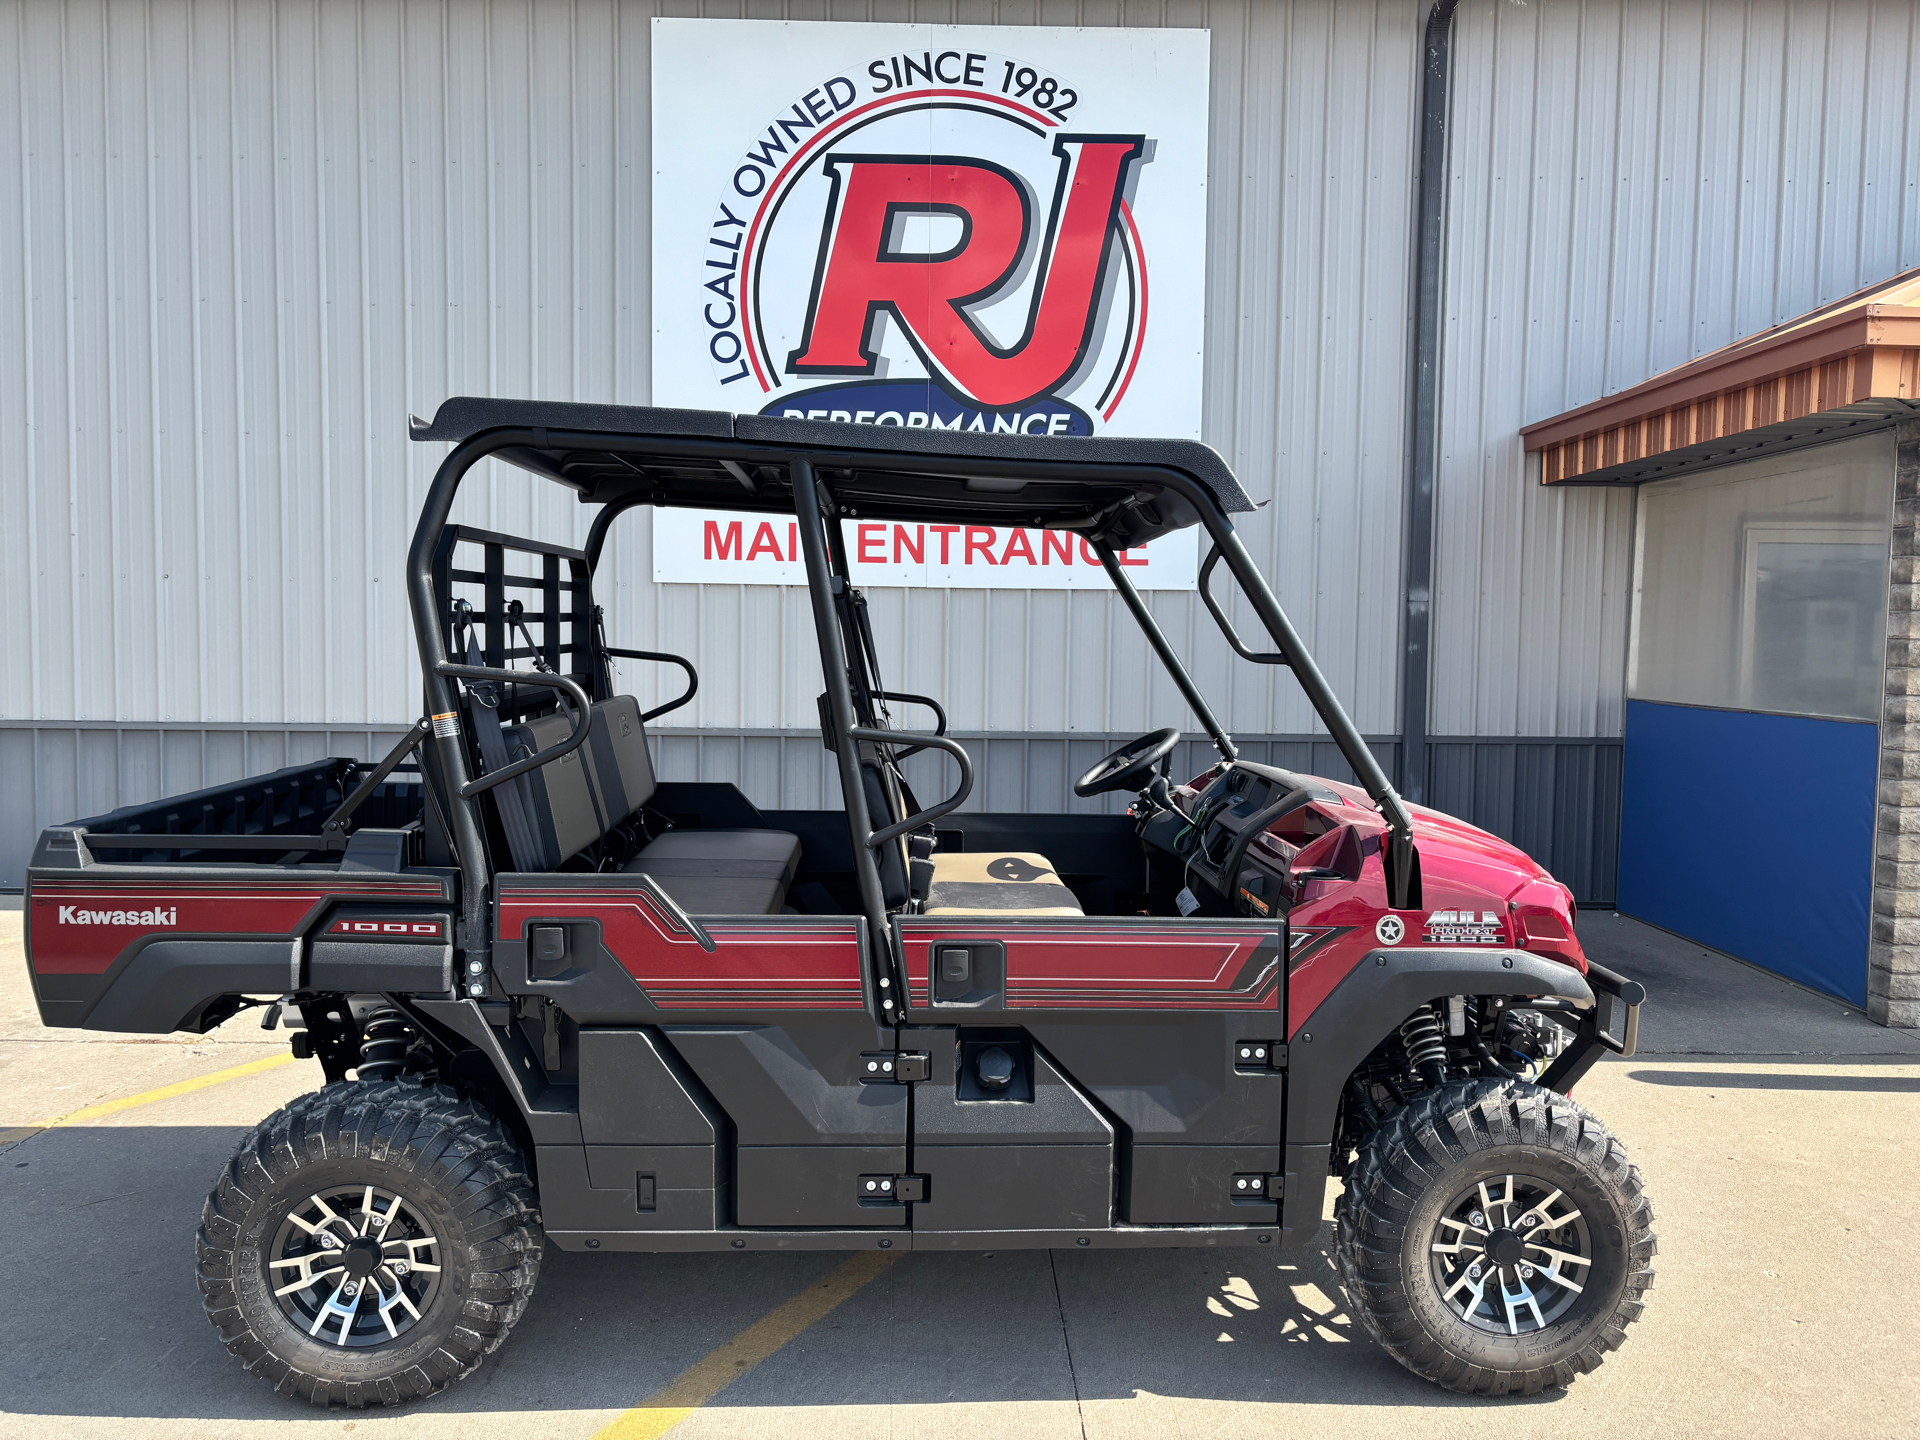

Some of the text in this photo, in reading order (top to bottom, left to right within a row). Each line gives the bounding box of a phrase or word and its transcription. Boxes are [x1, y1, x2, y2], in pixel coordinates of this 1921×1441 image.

[703, 51, 1079, 386] LOCALLY OWNED SINCE 1982
[785, 133, 1152, 407] RJ
[704, 520, 832, 563] MAI
[58, 905, 177, 926] Kawasaki
[340, 922, 437, 934] 1000
[1423, 910, 1504, 928] MULE
